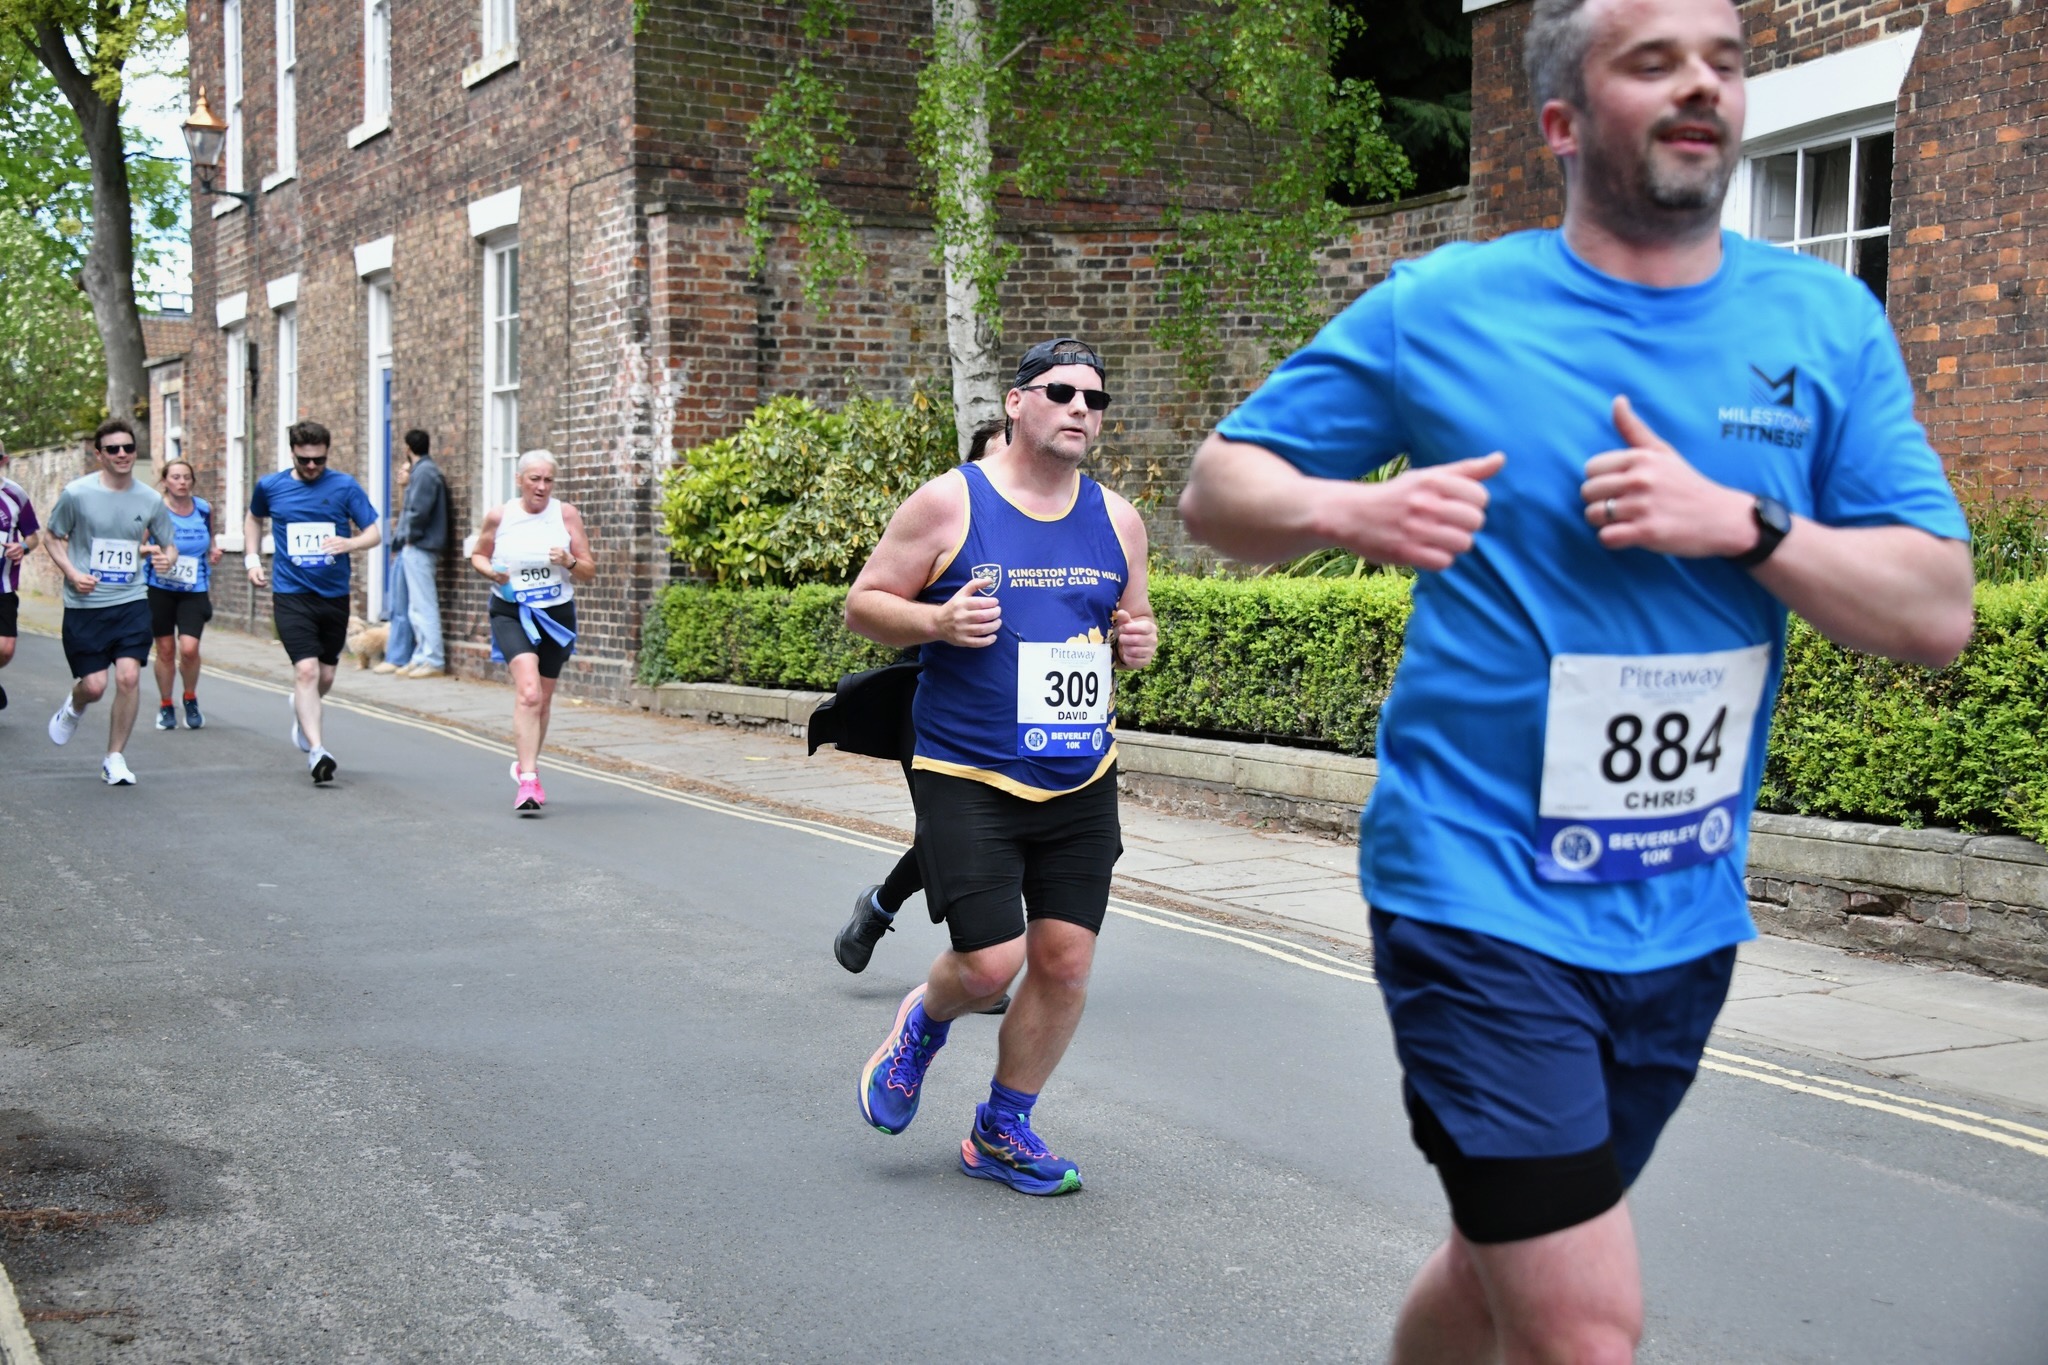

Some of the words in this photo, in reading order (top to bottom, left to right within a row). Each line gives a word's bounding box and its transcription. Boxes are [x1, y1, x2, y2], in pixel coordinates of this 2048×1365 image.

[1721, 423, 1803, 449] FITNESS
[98, 550, 133, 566] 1719
[521, 567, 550, 582] 560
[1008, 567, 1067, 578] KINGSTON
[1070, 567, 1101, 577] UPON
[1010, 577, 1065, 588] ATHLETIC
[1067, 576, 1099, 586] CLUB
[1051, 647, 1096, 662] Pittaway
[1620, 665, 1724, 689] Pittaway
[1044, 671, 1099, 707] 309
[1058, 711, 1088, 721] DAVID
[1051, 731, 1092, 741] BEVERLEY
[1601, 705, 1727, 783] 884
[1065, 741, 1081, 750] 10K
[1624, 787, 1695, 809] CHRIS
[1608, 824, 1698, 850] BEVERLEY
[1640, 847, 1673, 867] 10K
